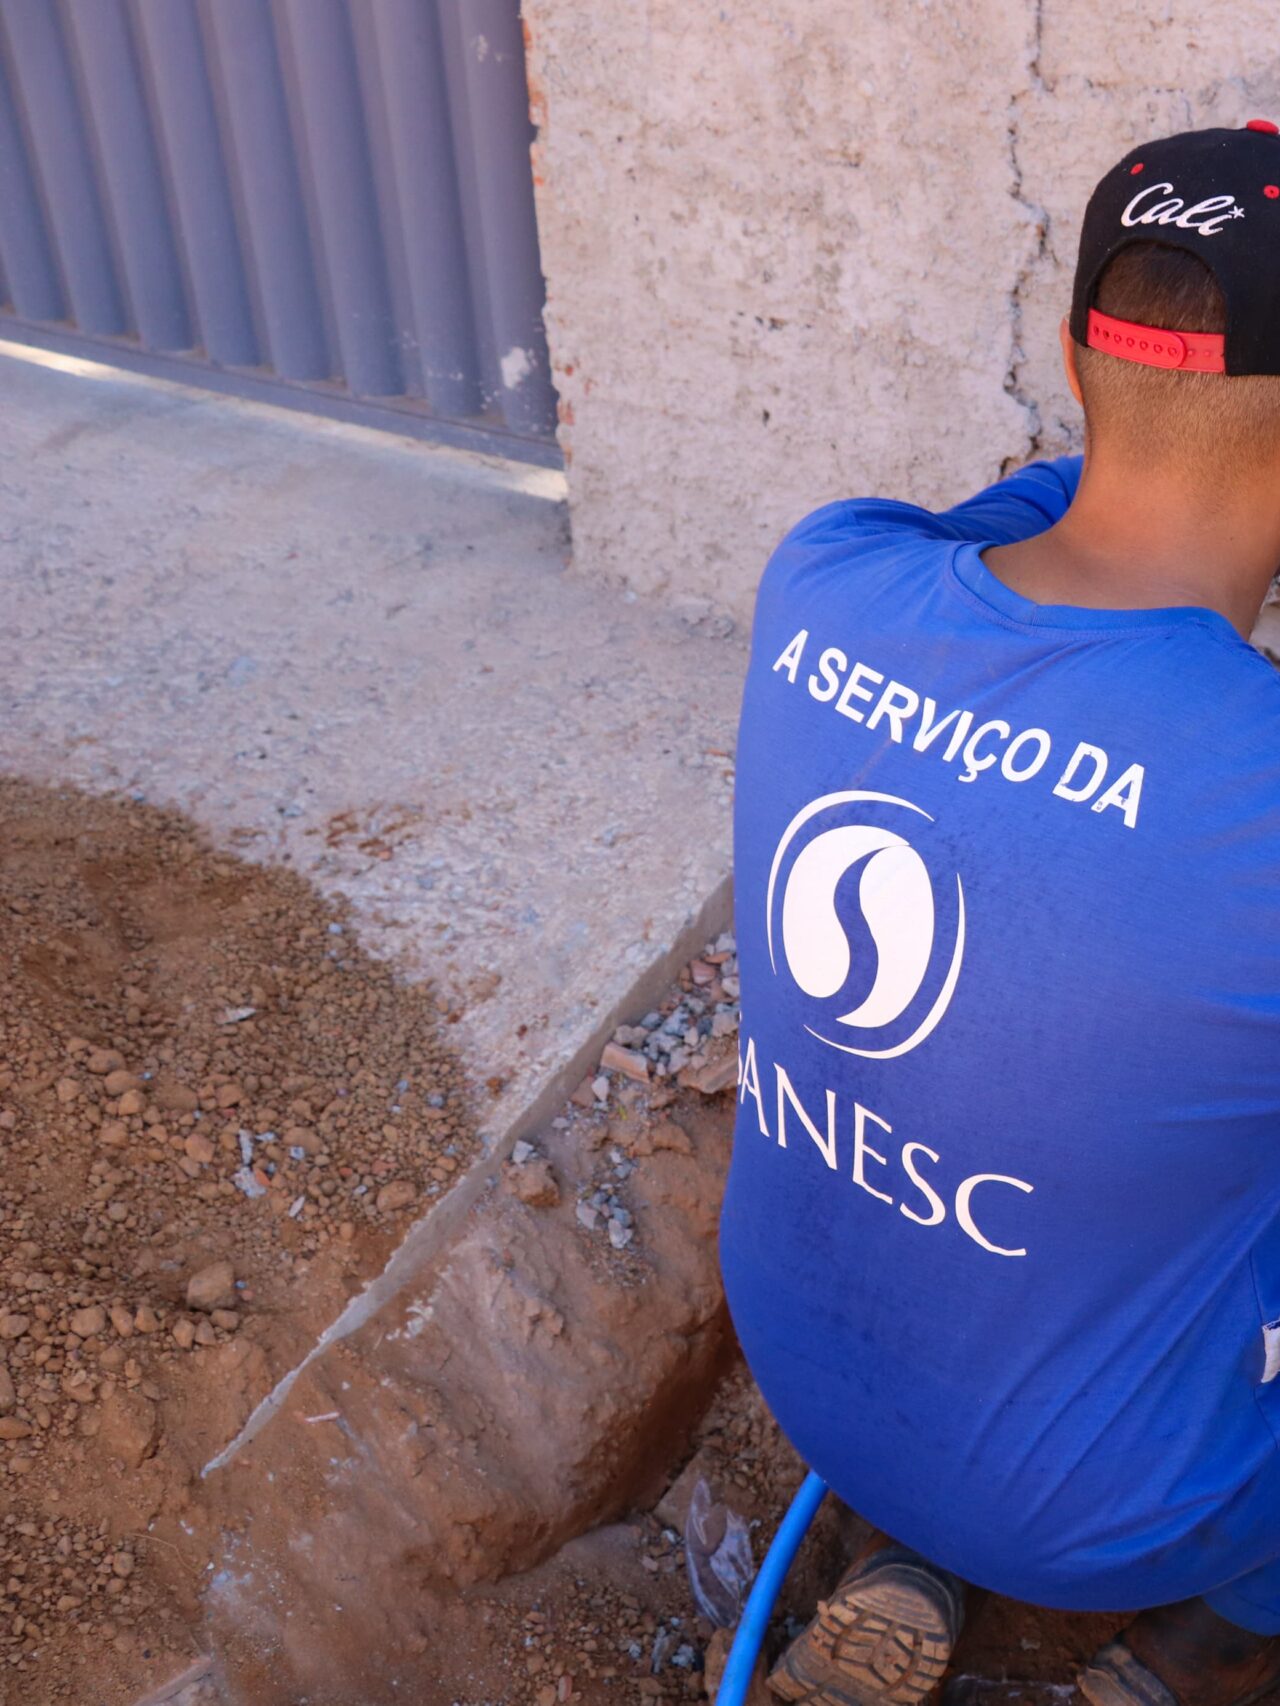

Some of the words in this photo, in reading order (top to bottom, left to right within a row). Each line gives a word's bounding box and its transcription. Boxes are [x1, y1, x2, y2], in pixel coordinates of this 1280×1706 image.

[772, 629, 809, 684] A
[808, 647, 1052, 783] SERVIÇO
[1052, 741, 1145, 829] DA
[737, 1010, 1034, 1257] ANESC
